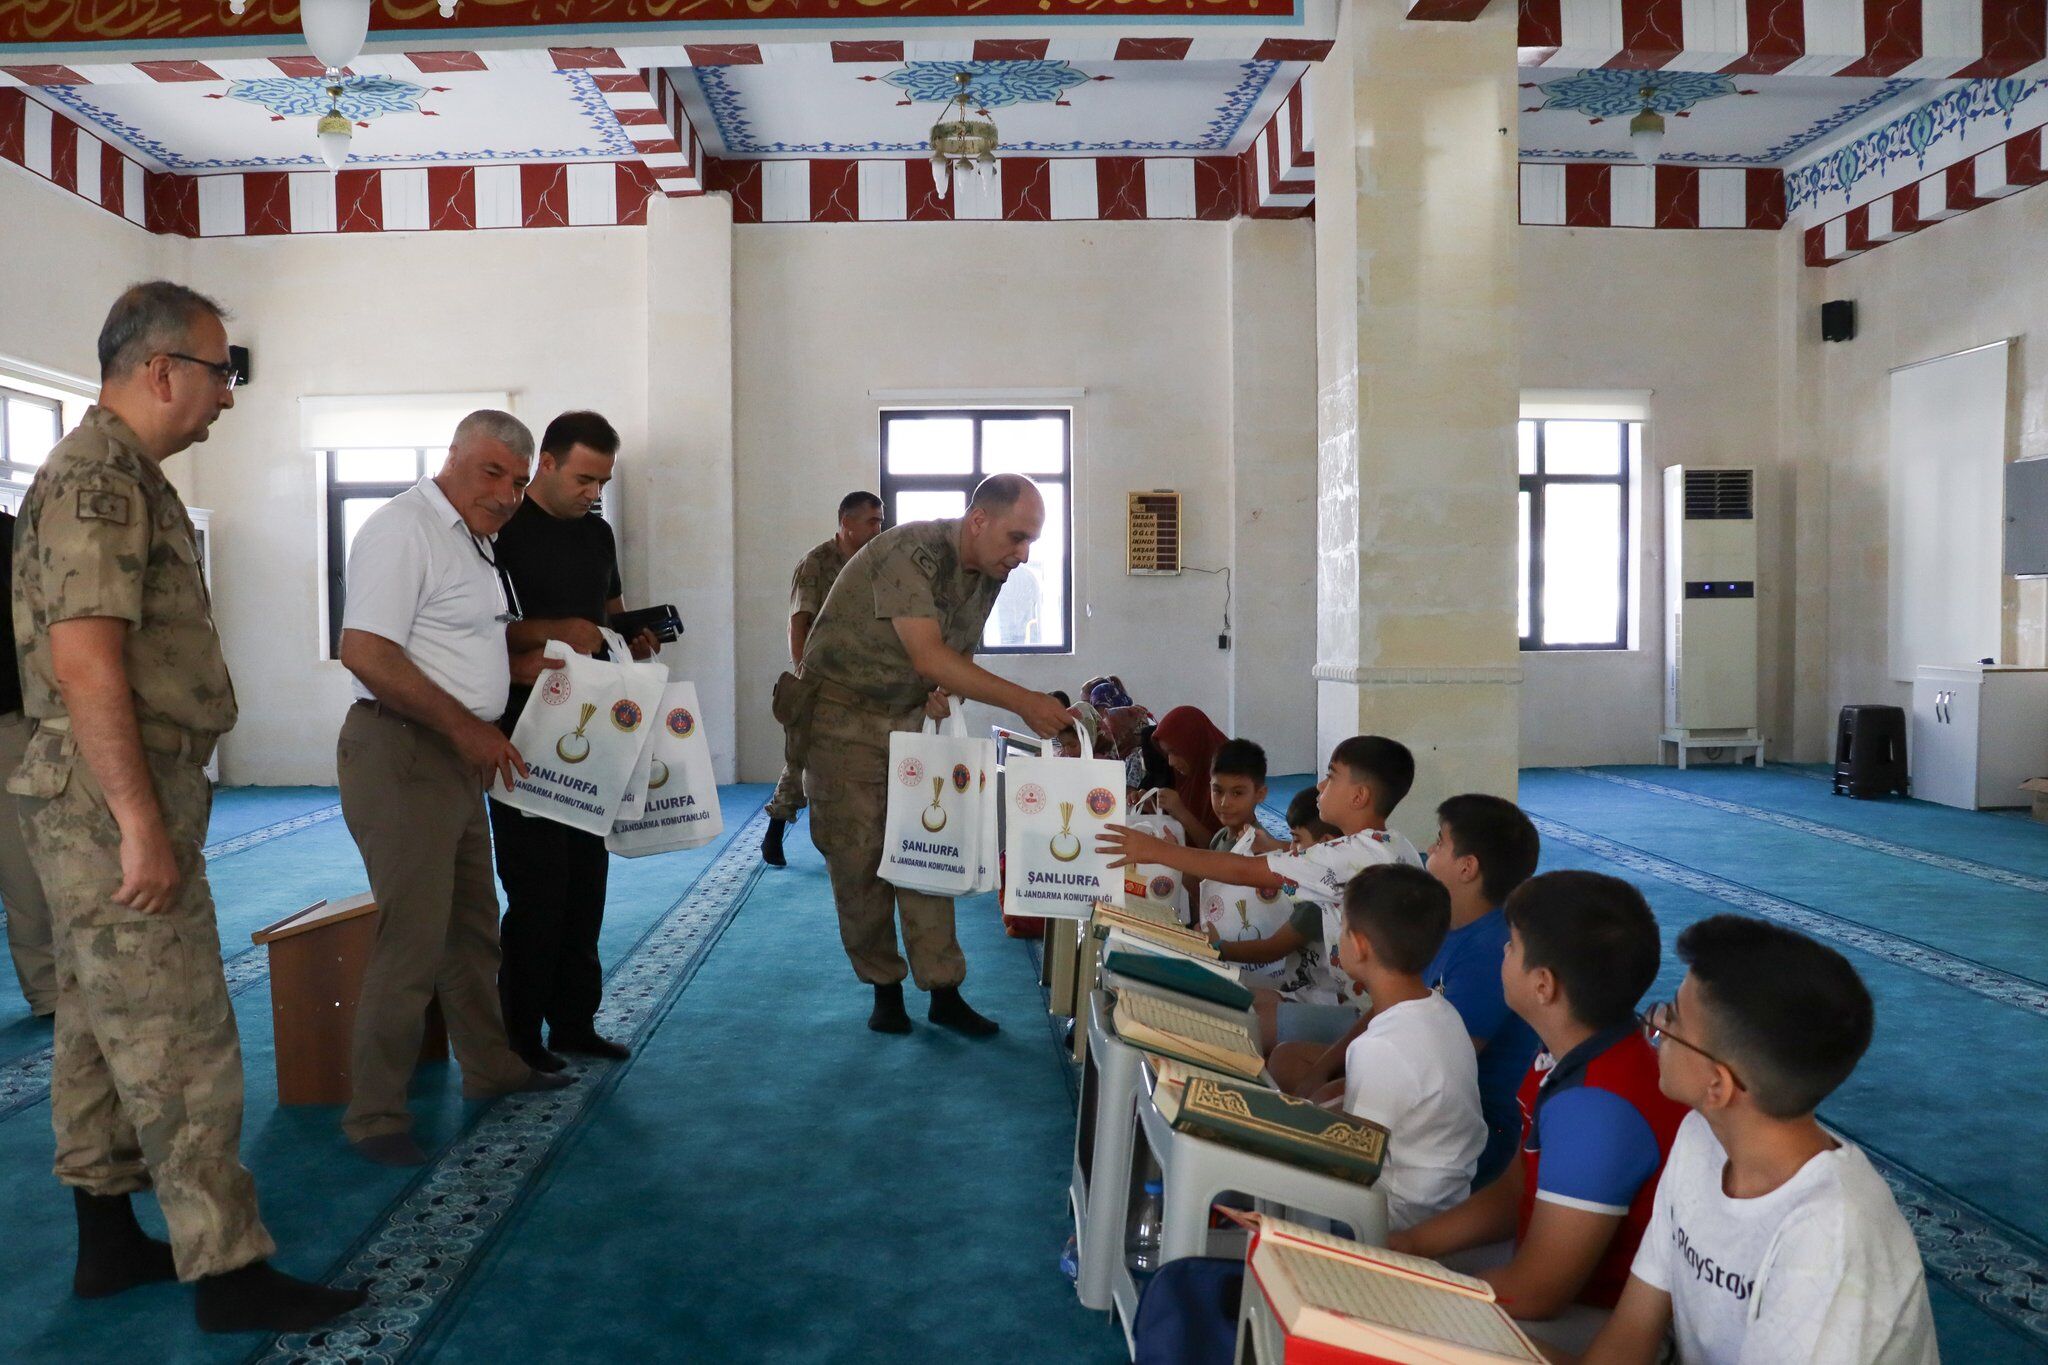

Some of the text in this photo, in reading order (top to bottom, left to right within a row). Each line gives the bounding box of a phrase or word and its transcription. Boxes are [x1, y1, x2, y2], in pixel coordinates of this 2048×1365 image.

[514, 780, 552, 799] JANDARMA
[553, 793, 605, 816] KOMUTANLIĞI
[620, 821, 660, 833] JANDARMA
[661, 811, 710, 826] KOMUTANLIĞI
[902, 839, 959, 857] ŞANLIURFA
[897, 856, 927, 868] JANDARMA
[928, 861, 966, 874] KOMUTANLIĞI
[1027, 871, 1100, 887] ŞANLIURFA
[1015, 887, 1022, 897] İL
[1024, 889, 1062, 900] JANDARMA
